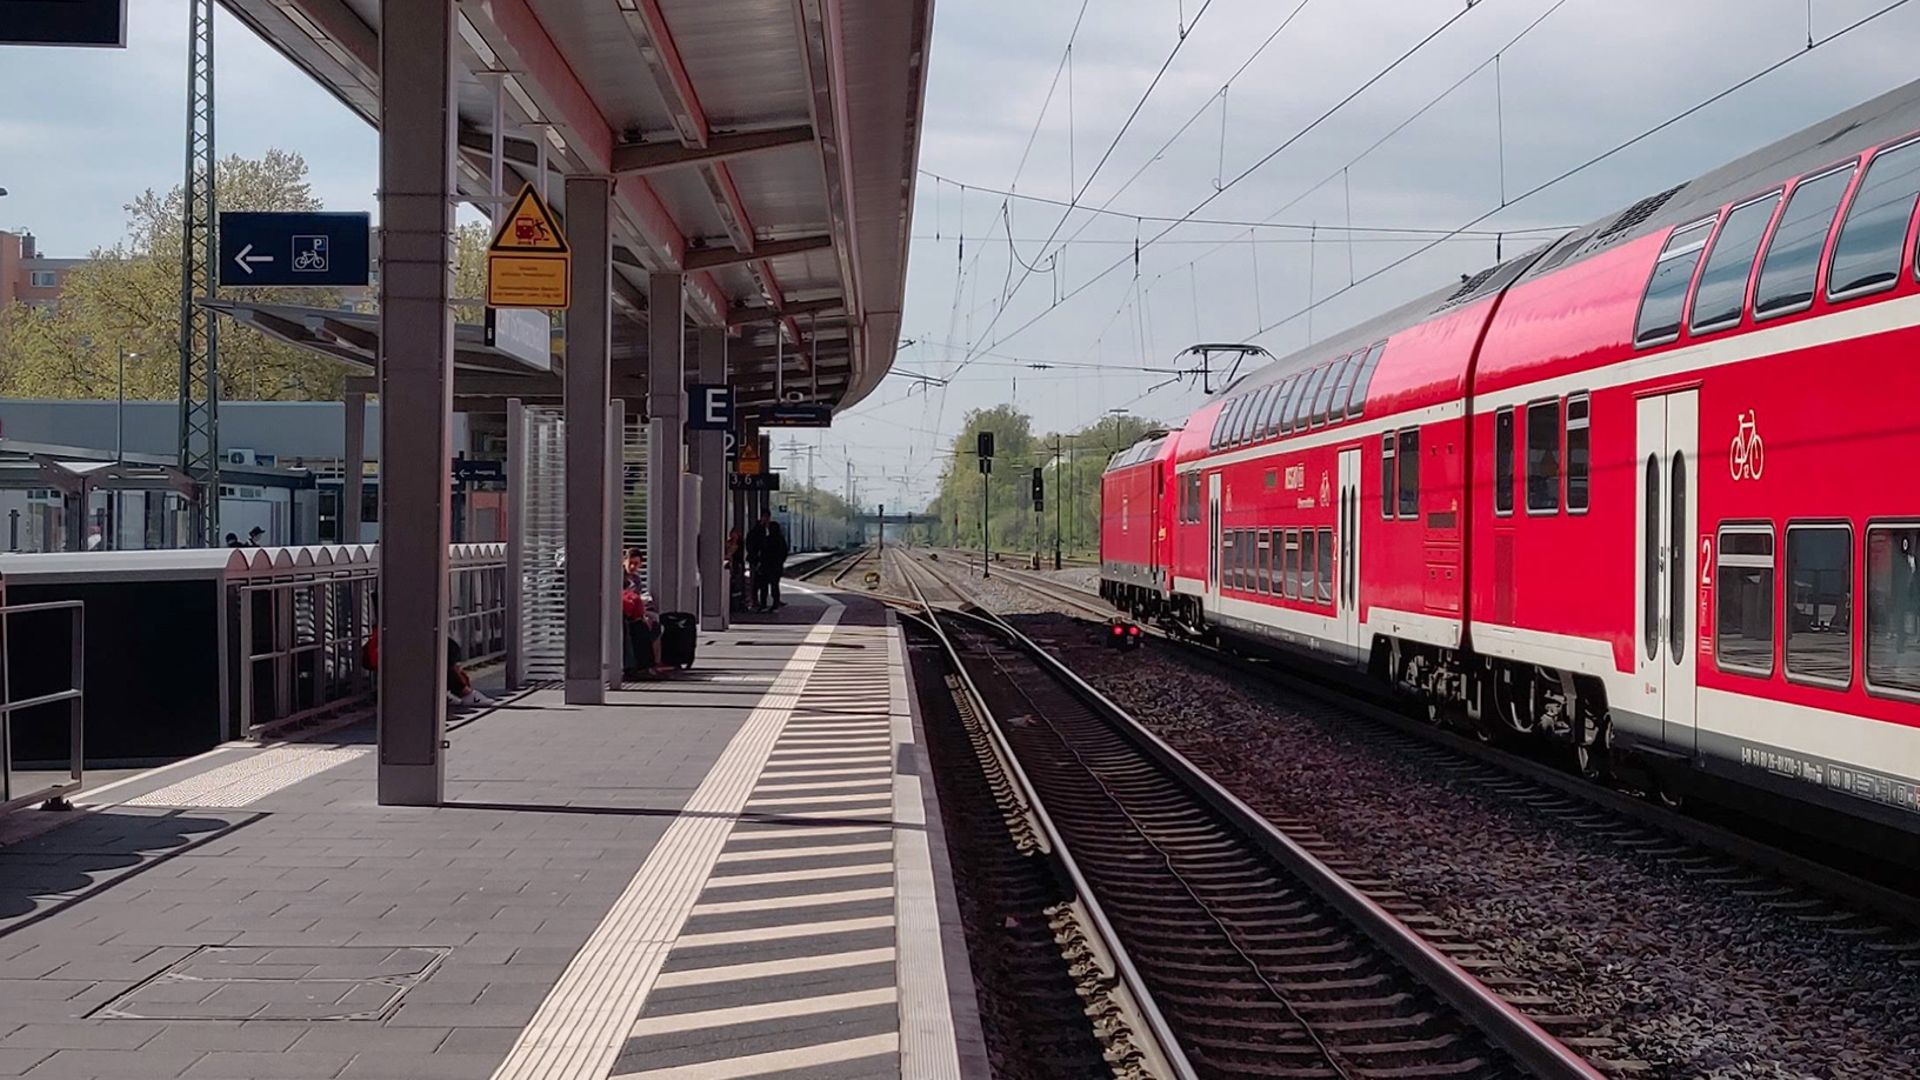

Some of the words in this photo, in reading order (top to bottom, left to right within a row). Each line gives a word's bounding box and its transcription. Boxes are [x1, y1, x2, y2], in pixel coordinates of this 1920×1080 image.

[313, 238, 322, 250] P
[706, 389, 728, 422] E
[1701, 538, 1711, 584] 2
